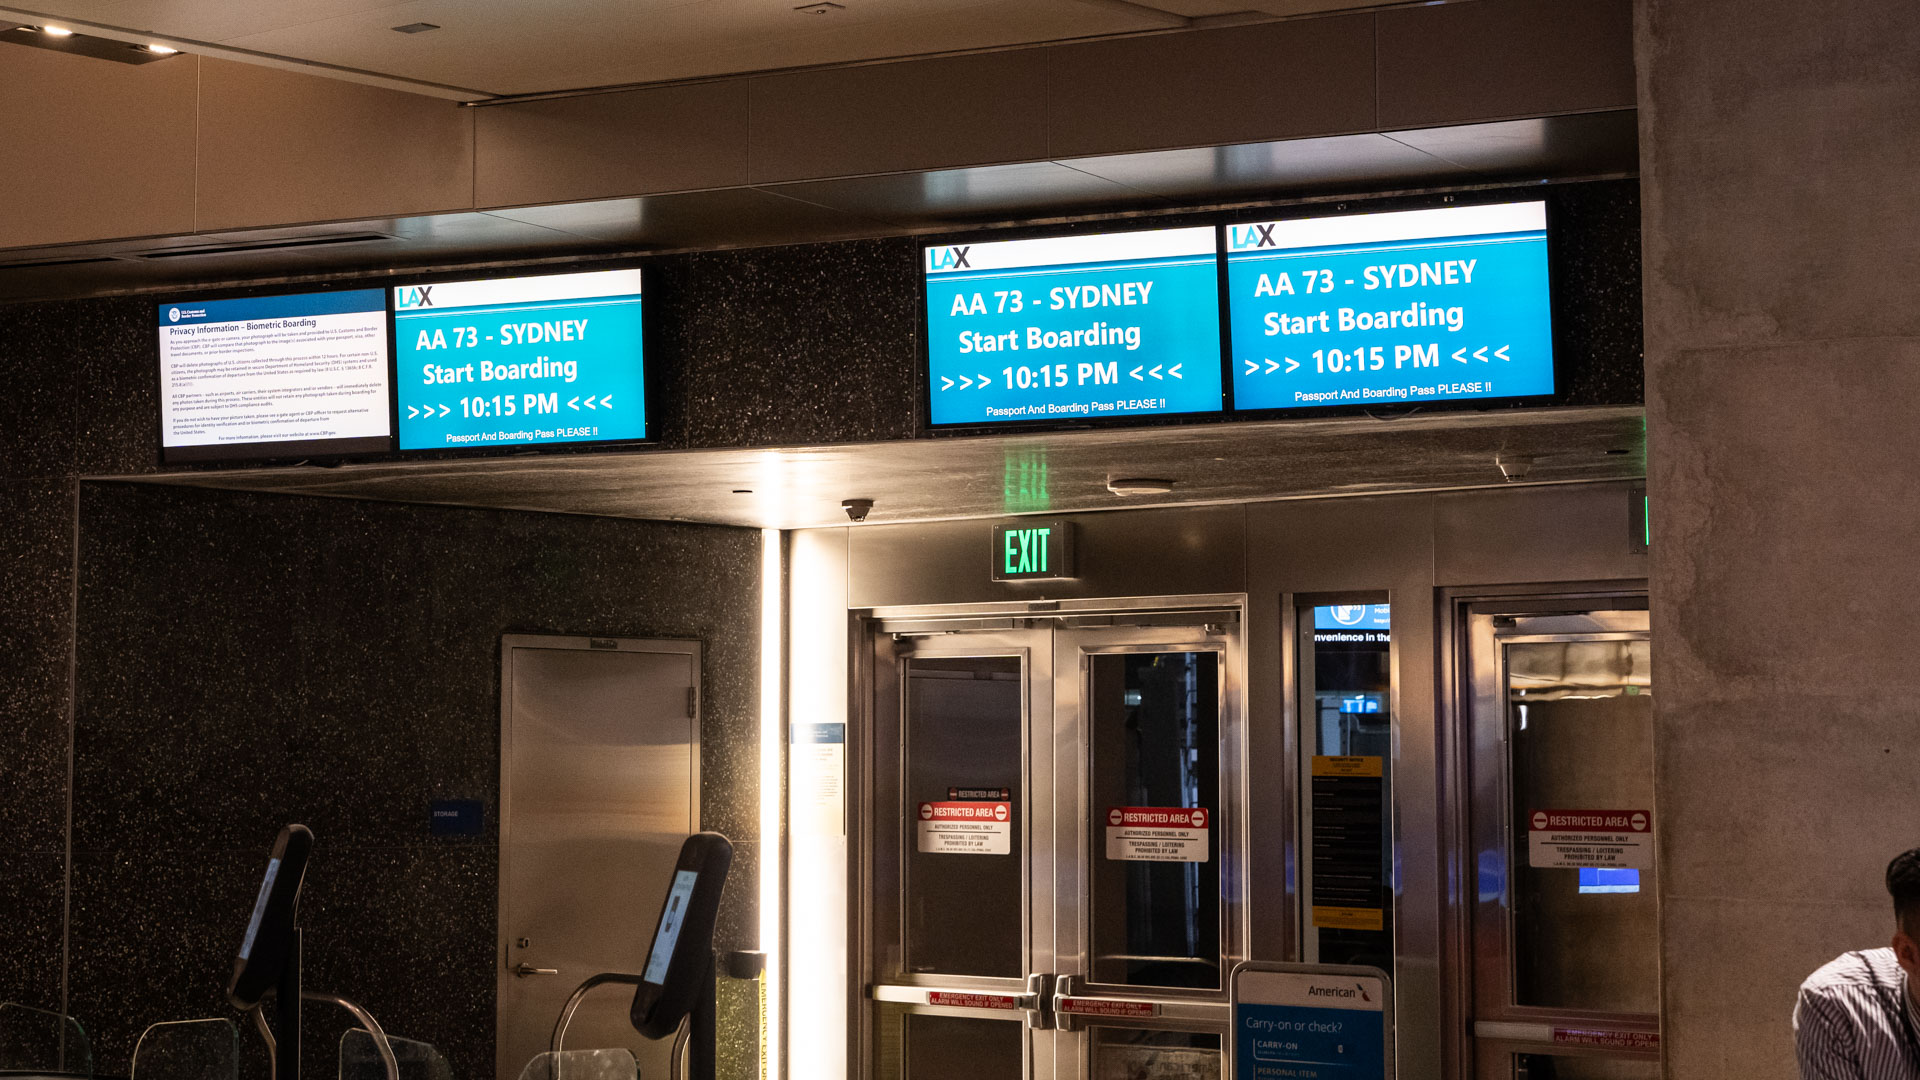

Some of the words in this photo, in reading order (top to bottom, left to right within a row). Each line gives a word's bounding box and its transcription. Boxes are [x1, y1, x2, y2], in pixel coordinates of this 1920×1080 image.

[1232, 224, 1276, 248] LAX
[930, 246, 970, 270] LAX
[1255, 273, 1295, 297] AA
[1303, 269, 1334, 293] 73
[1364, 259, 1476, 290] SYDNEY
[399, 286, 433, 308] LAX
[951, 293, 987, 316] AA
[994, 290, 1023, 313] 73
[1050, 281, 1153, 310] SYDNEY
[170, 327, 195, 336] Privacy
[197, 324, 240, 334] Information
[247, 321, 281, 330] Biometric
[283, 319, 316, 329] Boarding
[1264, 308, 1329, 336] Start
[1339, 302, 1463, 331] Boarding
[416, 329, 447, 350] AA
[453, 327, 478, 348] 73
[501, 319, 588, 345] SYDNEY
[959, 327, 1018, 353] Start
[1027, 322, 1140, 350] Boarding
[1313, 347, 1384, 373] 10:15
[1395, 344, 1439, 368] PM
[423, 361, 474, 384] Start
[481, 356, 577, 382] Boarding
[1003, 364, 1068, 389] 10:15
[1078, 362, 1118, 385] PM
[1295, 391, 1338, 402] Passport
[1340, 389, 1359, 399] And
[1363, 387, 1407, 398] Boarding
[1410, 386, 1435, 395] Pass
[1438, 382, 1482, 394] PLEASE
[461, 395, 516, 417] 10:15
[524, 393, 558, 414] PM
[987, 406, 1026, 417] Passport
[1028, 405, 1045, 414] And
[1048, 403, 1088, 414] Boarding
[1092, 402, 1114, 411] Pass
[1117, 399, 1157, 409] PLEASE
[447, 433, 480, 443] Passport
[481, 432, 496, 440] And
[499, 431, 533, 440] Boarding
[535, 430, 554, 438] Pass
[557, 427, 590, 437] PLEASE
[1004, 528, 1050, 573] EXIT
[1314, 632, 1364, 642] nvenience
[1366, 633, 1375, 641] in
[958, 790, 987, 798] RESTRICTED
[934, 807, 974, 816] RESTRICTED
[975, 808, 993, 817] AREA
[1124, 813, 1168, 823] RESTRICTED
[1170, 814, 1189, 823] AREA
[1550, 816, 1603, 826] RESTRICTED
[1605, 816, 1629, 827] AREA
[940, 992, 974, 1000] EMERGENCY
[1308, 986, 1356, 998] American
[1073, 1000, 1110, 1008] EMERGENCY
[1246, 1017, 1292, 1032] Carry-on
[1296, 1022, 1305, 1031] or
[1308, 1020, 1342, 1033] check?
[1567, 1029, 1613, 1037] EMERGENCY
[1257, 1041, 1298, 1050] CARRY-ON
[1600, 1038, 1625, 1046] SOUND
[1635, 1040, 1659, 1048] OPENE
[1257, 1067, 1297, 1077] PERSONAL
[1299, 1069, 1318, 1078] ITEM
